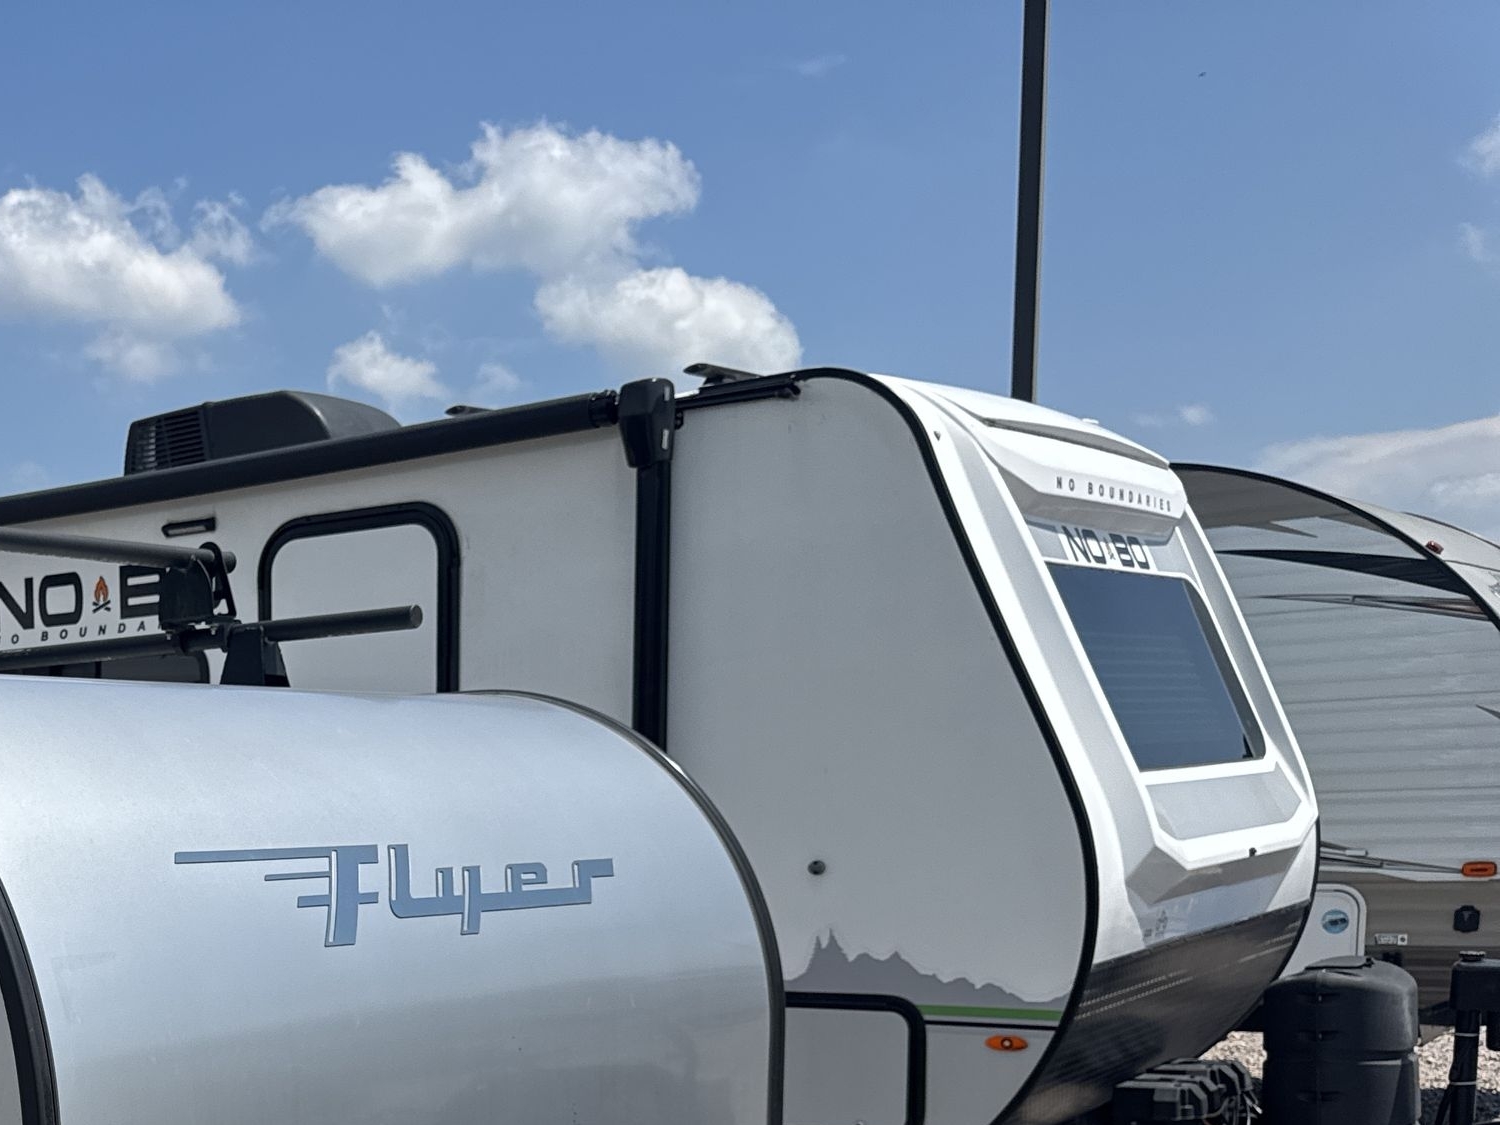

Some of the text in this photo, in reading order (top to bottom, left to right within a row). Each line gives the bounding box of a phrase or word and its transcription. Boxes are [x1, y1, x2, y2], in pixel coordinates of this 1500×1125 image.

[1056, 475, 1171, 512] NO BOUNDARIES
[1061, 525, 1107, 565] NO
[174, 843, 615, 948] Flyer
